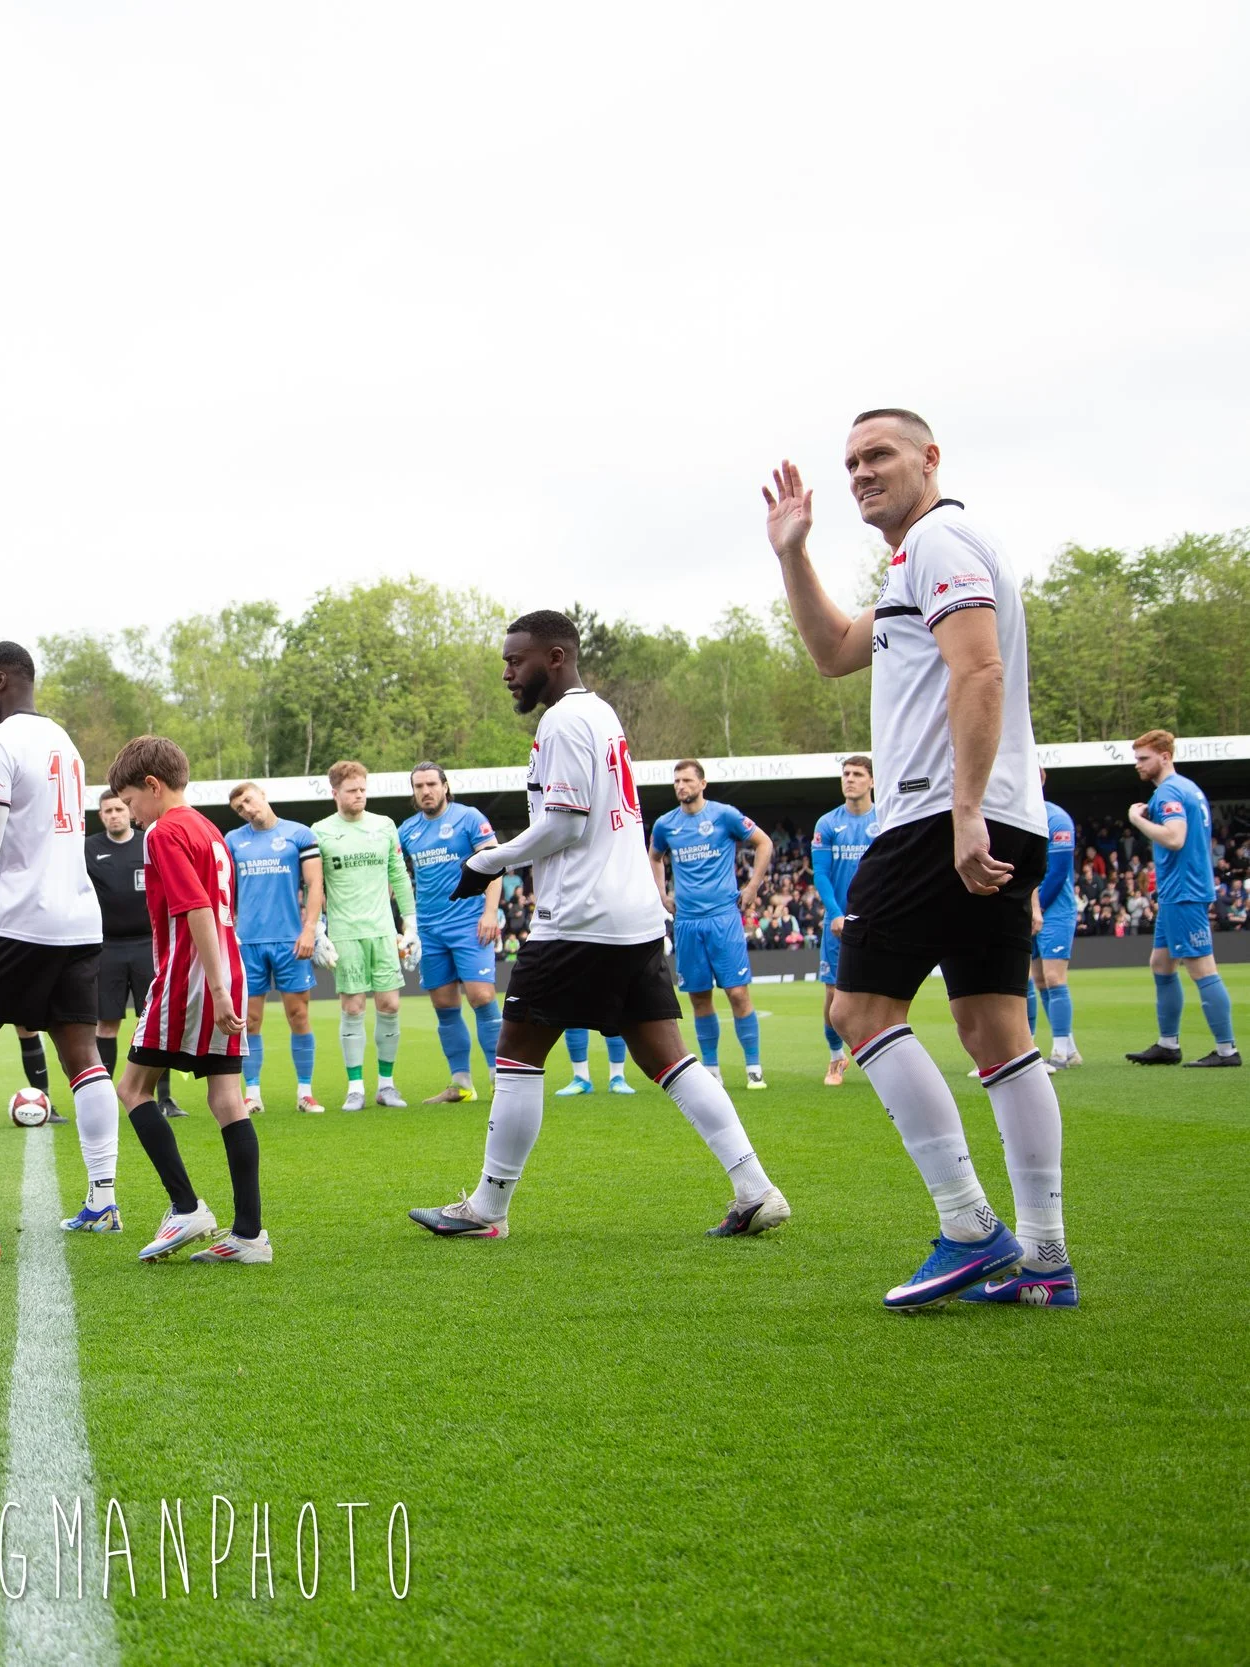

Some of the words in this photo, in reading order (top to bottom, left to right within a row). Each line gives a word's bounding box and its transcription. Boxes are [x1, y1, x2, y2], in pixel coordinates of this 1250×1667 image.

[416, 847, 448, 859] BARROW
[679, 843, 710, 855] BARROW
[343, 852, 377, 861] BARROW
[418, 853, 460, 867] ELECTRICAL
[680, 849, 721, 863] ELECTRICAL
[247, 858, 281, 867] BARROW
[344, 858, 385, 868] ELECTRICAL
[248, 865, 291, 875] ELECTRICAL
